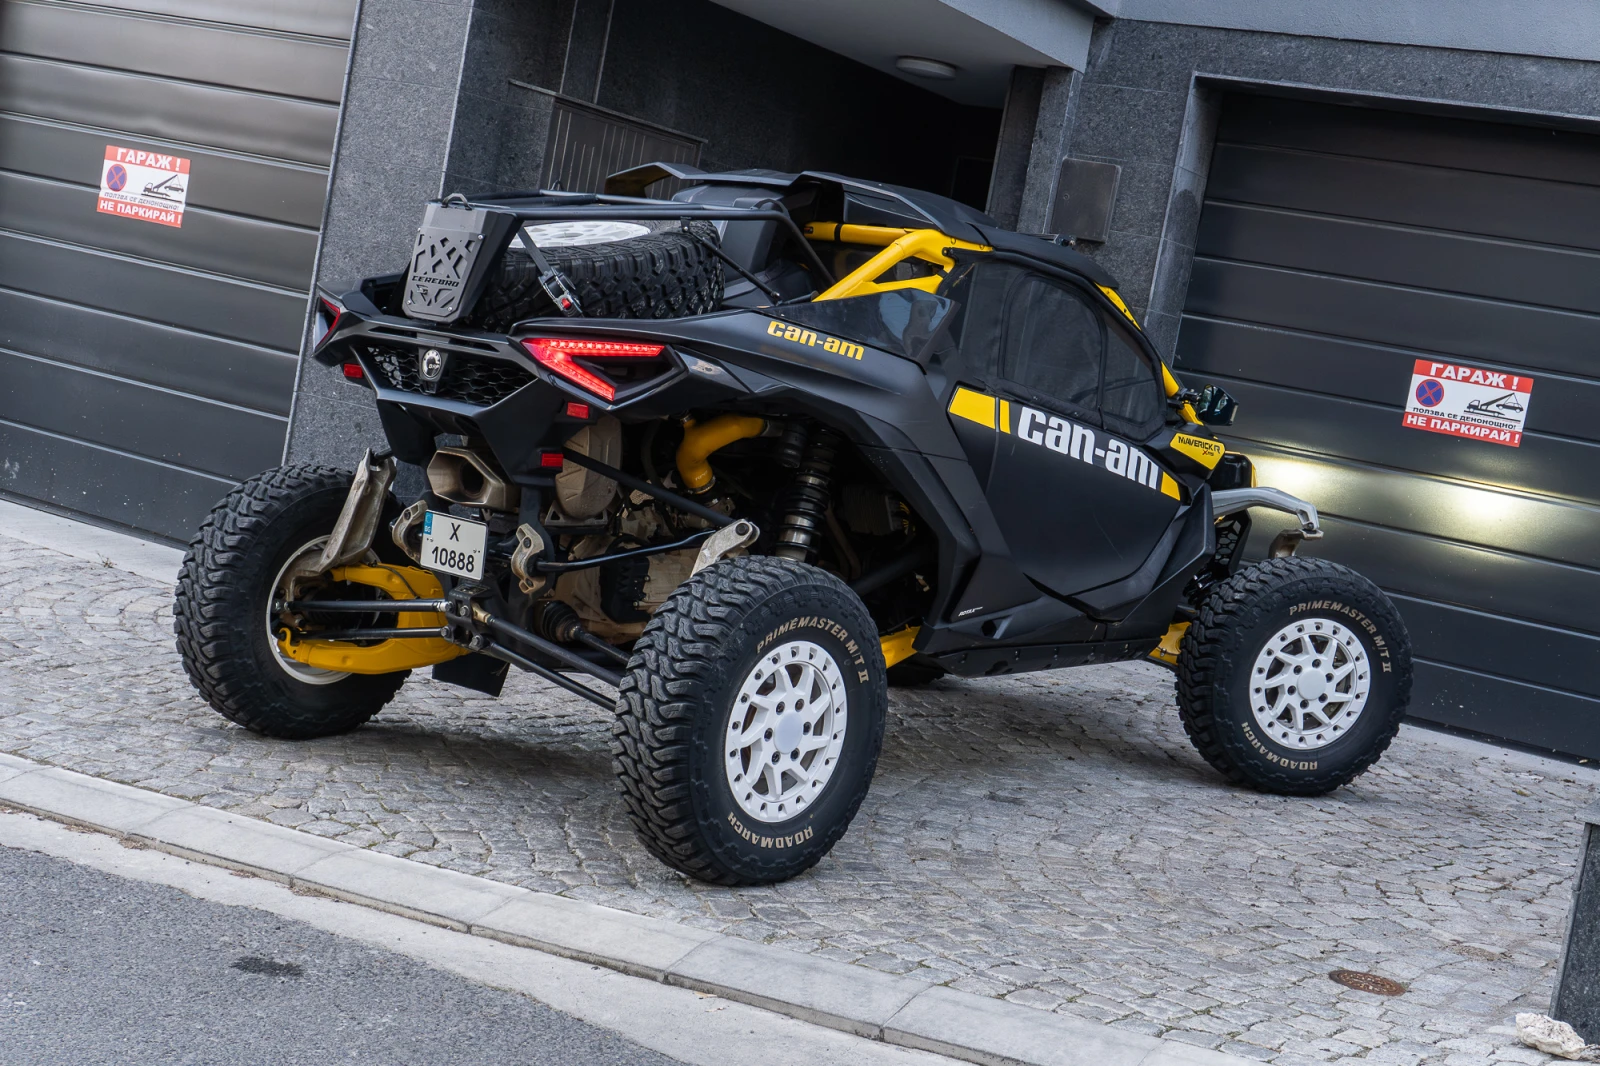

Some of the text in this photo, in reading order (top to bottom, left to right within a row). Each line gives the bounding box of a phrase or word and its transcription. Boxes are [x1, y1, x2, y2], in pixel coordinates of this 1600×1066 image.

[116, 148, 173, 170] ГАРАЖ
[100, 200, 115, 211] НЕ
[117, 203, 175, 223] ПАРКИРАЙ
[412, 275, 460, 288] CEREBRO
[767, 320, 865, 361] can-am
[1430, 362, 1506, 388] ГАРАЖ
[1406, 414, 1427, 427] НЕ
[1430, 417, 1511, 442] ПАРКИРАЙ
[1412, 407, 1445, 418] ПОЛЗВА
[1459, 415, 1517, 430] ДЕНОНОЩНО!
[1017, 406, 1159, 490] can-am
[1177, 435, 1213, 451] MAVERICK
[431, 546, 475, 573] 10888
[756, 616, 849, 653] PRIMEMASTER
[844, 639, 865, 666] M/T
[1289, 600, 1377, 634] PRIMEMASTER
[1373, 633, 1390, 658] M/T
[1241, 721, 1319, 771] ROADMARCH
[727, 811, 815, 850] ROADMARCH
